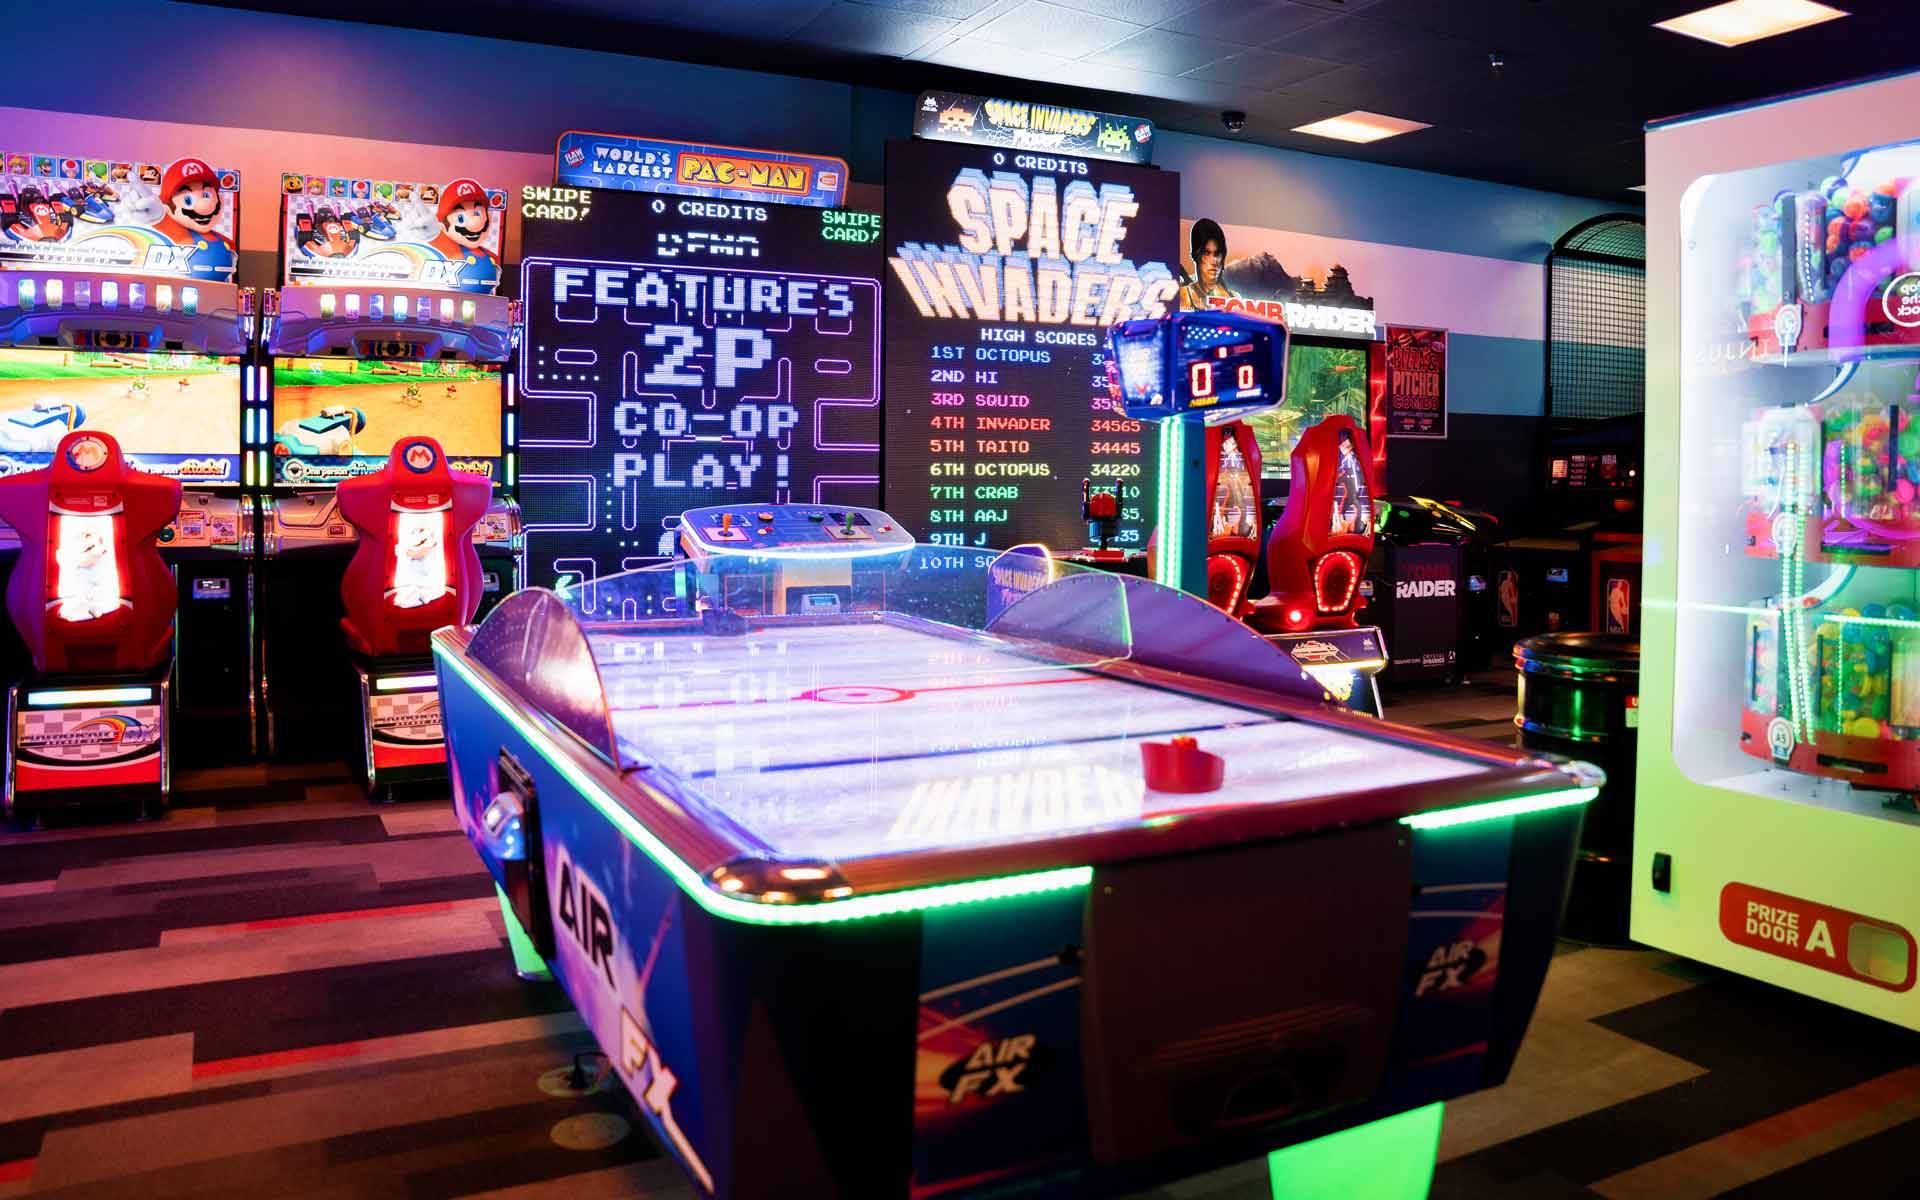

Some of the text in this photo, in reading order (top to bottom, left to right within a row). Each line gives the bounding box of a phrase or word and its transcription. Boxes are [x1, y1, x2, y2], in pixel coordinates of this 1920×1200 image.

[985, 97, 1029, 127] SPACE
[596, 147, 671, 165] WORLD'S
[1015, 155, 1088, 175] CREDITS
[592, 160, 673, 179] LARGEST
[683, 158, 807, 191] PAC-MAN
[522, 185, 593, 204] SWIPE
[678, 202, 768, 221] CREDITS
[822, 210, 881, 228] SWIPE
[946, 167, 1139, 264] SPACE
[554, 267, 853, 316] FEATURES
[888, 240, 1180, 326] INVADERS
[1286, 303, 1376, 335] RAIDER
[981, 328, 1025, 342] HIGH
[1035, 331, 1097, 346] SCORES
[644, 325, 773, 387] 2P
[931, 346, 1051, 363] 1ST OCTOPUS
[930, 370, 998, 384] 2ND HI
[1192, 362, 1212, 397] 0
[1239, 365, 1254, 389] 0
[1393, 371, 1440, 396] PITCHER
[930, 393, 1029, 408] 3RD SQUID
[613, 402, 799, 438] CO-OP
[930, 416, 1141, 432] 4TH INVADER 34565
[930, 440, 1141, 454] 5TH TAITO 34445
[613, 454, 789, 487] PLAY!
[930, 463, 1140, 476] 6TH OCTOPUS 34220
[930, 487, 965, 499] 7TH
[975, 487, 1018, 499] CRAB
[930, 510, 1008, 522] 8TH AAJ
[930, 533, 986, 545] 9TH J
[919, 556, 964, 569] 10TH
[1396, 580, 1456, 599] RAIDER
[559, 860, 616, 988] AIR
[1746, 901, 1799, 930] PRIZE
[1746, 917, 1799, 948] DOOR
[1805, 919, 1836, 958] A
[1428, 940, 1473, 968] AIR
[1416, 967, 1465, 997] FX
[966, 1033, 1036, 1069] AIR
[951, 1062, 1026, 1103] FX
